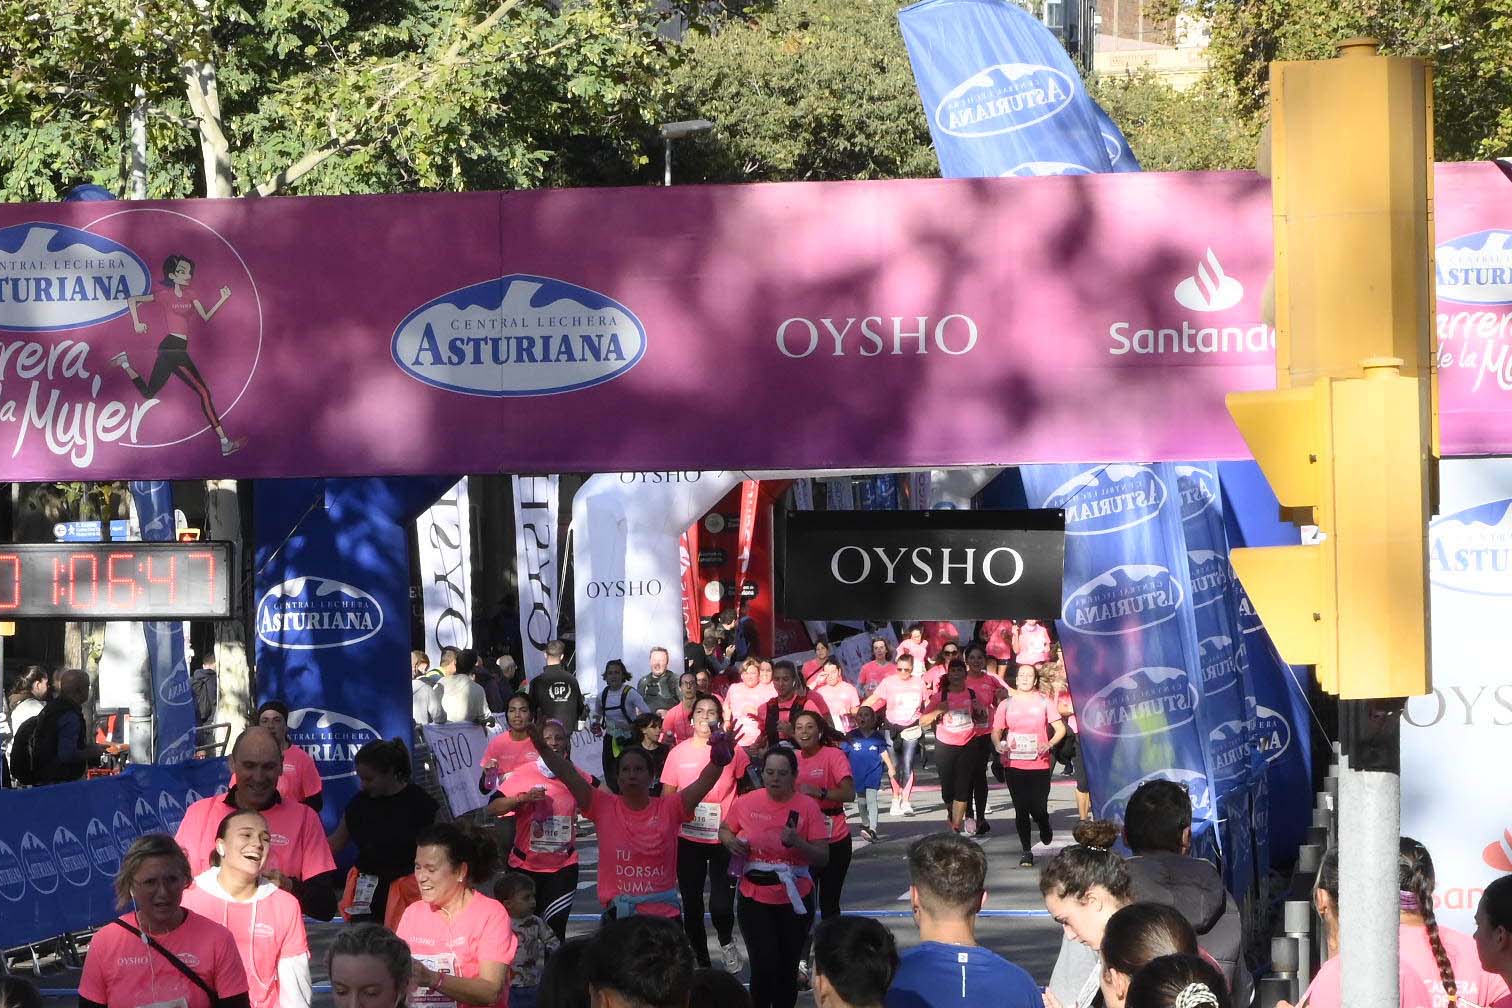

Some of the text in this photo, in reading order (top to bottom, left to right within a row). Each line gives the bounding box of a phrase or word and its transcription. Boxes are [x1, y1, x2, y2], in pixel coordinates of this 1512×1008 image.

[53, 259, 126, 270] LECHERA
[451, 315, 618, 331] CENTRAL LECHERA
[775, 313, 979, 358] OYSHO
[412, 322, 626, 367] ASTURIANA
[11, 375, 161, 469] Mujer
[830, 545, 1025, 588] OYSHO
[586, 578, 663, 599] OYSHO
[260, 606, 374, 634] ASTURIANA
[616, 849, 631, 861] TU
